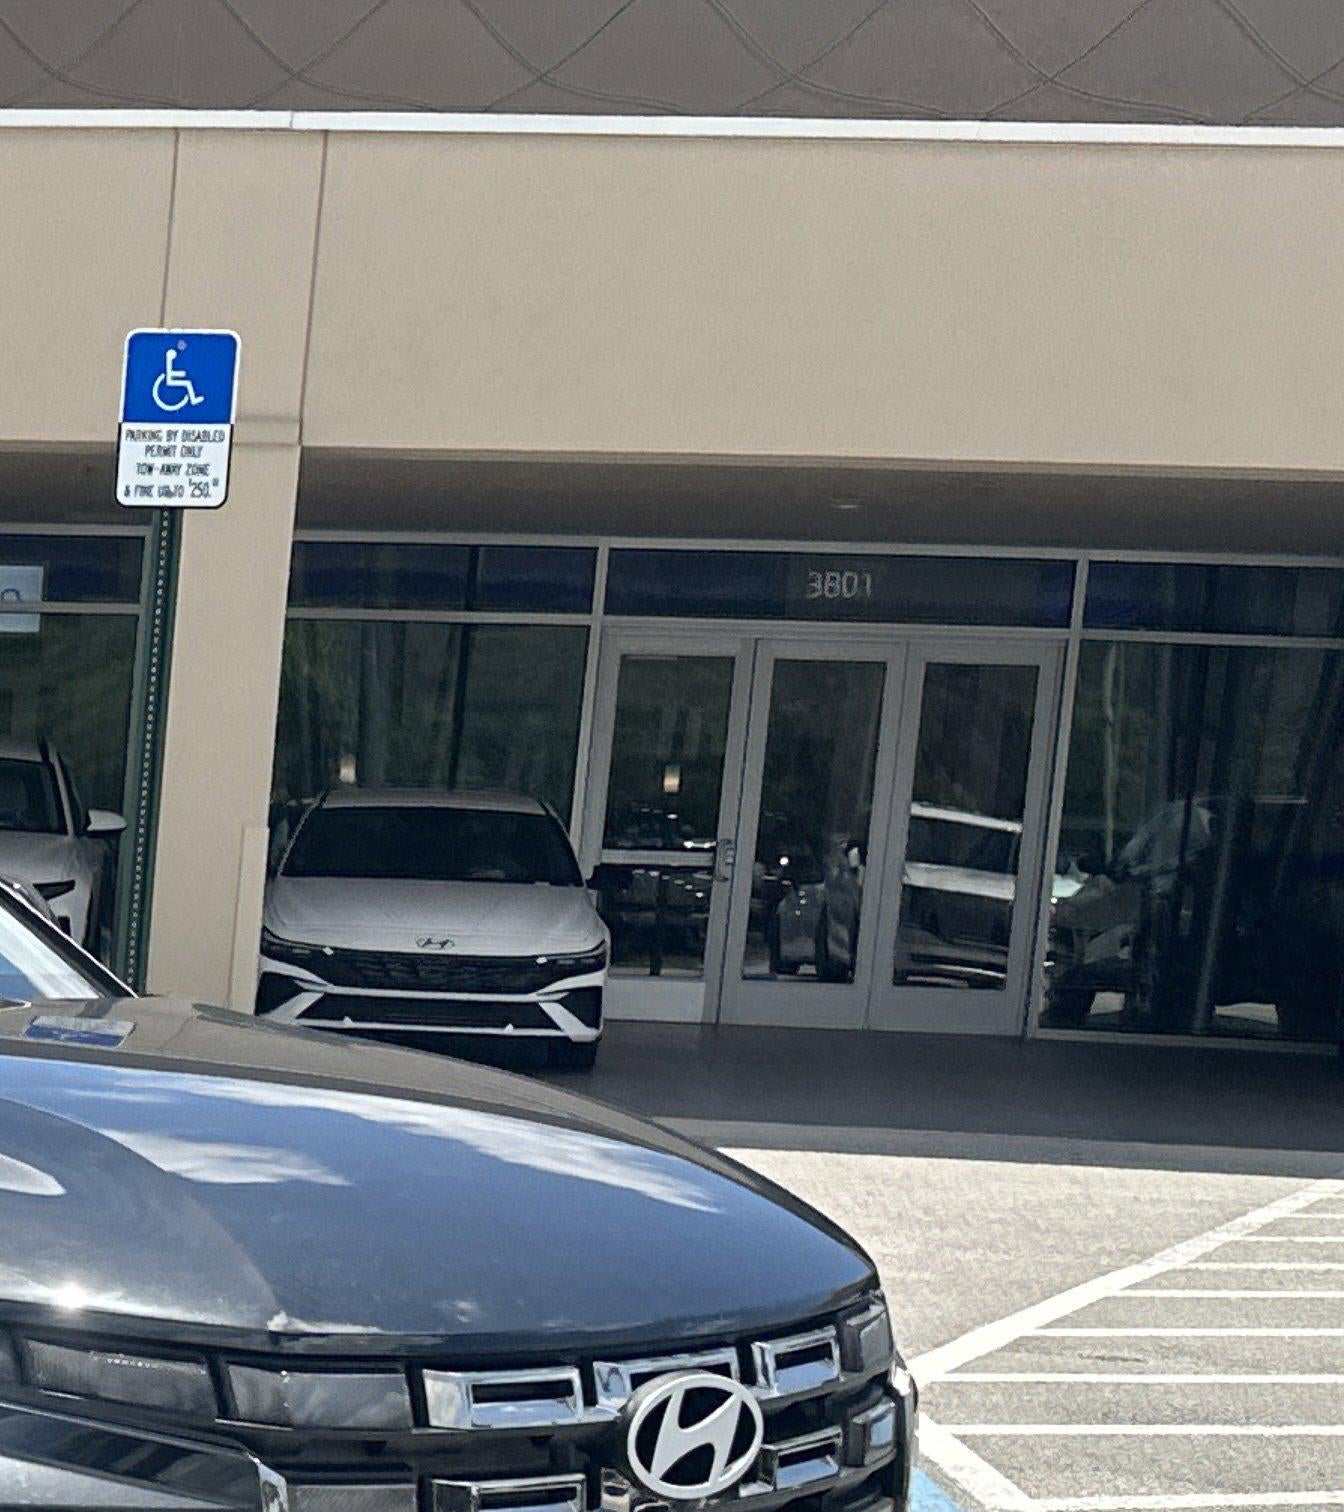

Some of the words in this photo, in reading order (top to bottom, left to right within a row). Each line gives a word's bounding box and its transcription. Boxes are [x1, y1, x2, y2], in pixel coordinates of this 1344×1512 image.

[125, 429, 163, 442] PARKING
[166, 430, 179, 442] BY
[181, 430, 226, 443] DISABLED
[144, 445, 177, 458] PERMIT
[180, 446, 204, 458] ONLY
[185, 463, 210, 476] ZONE
